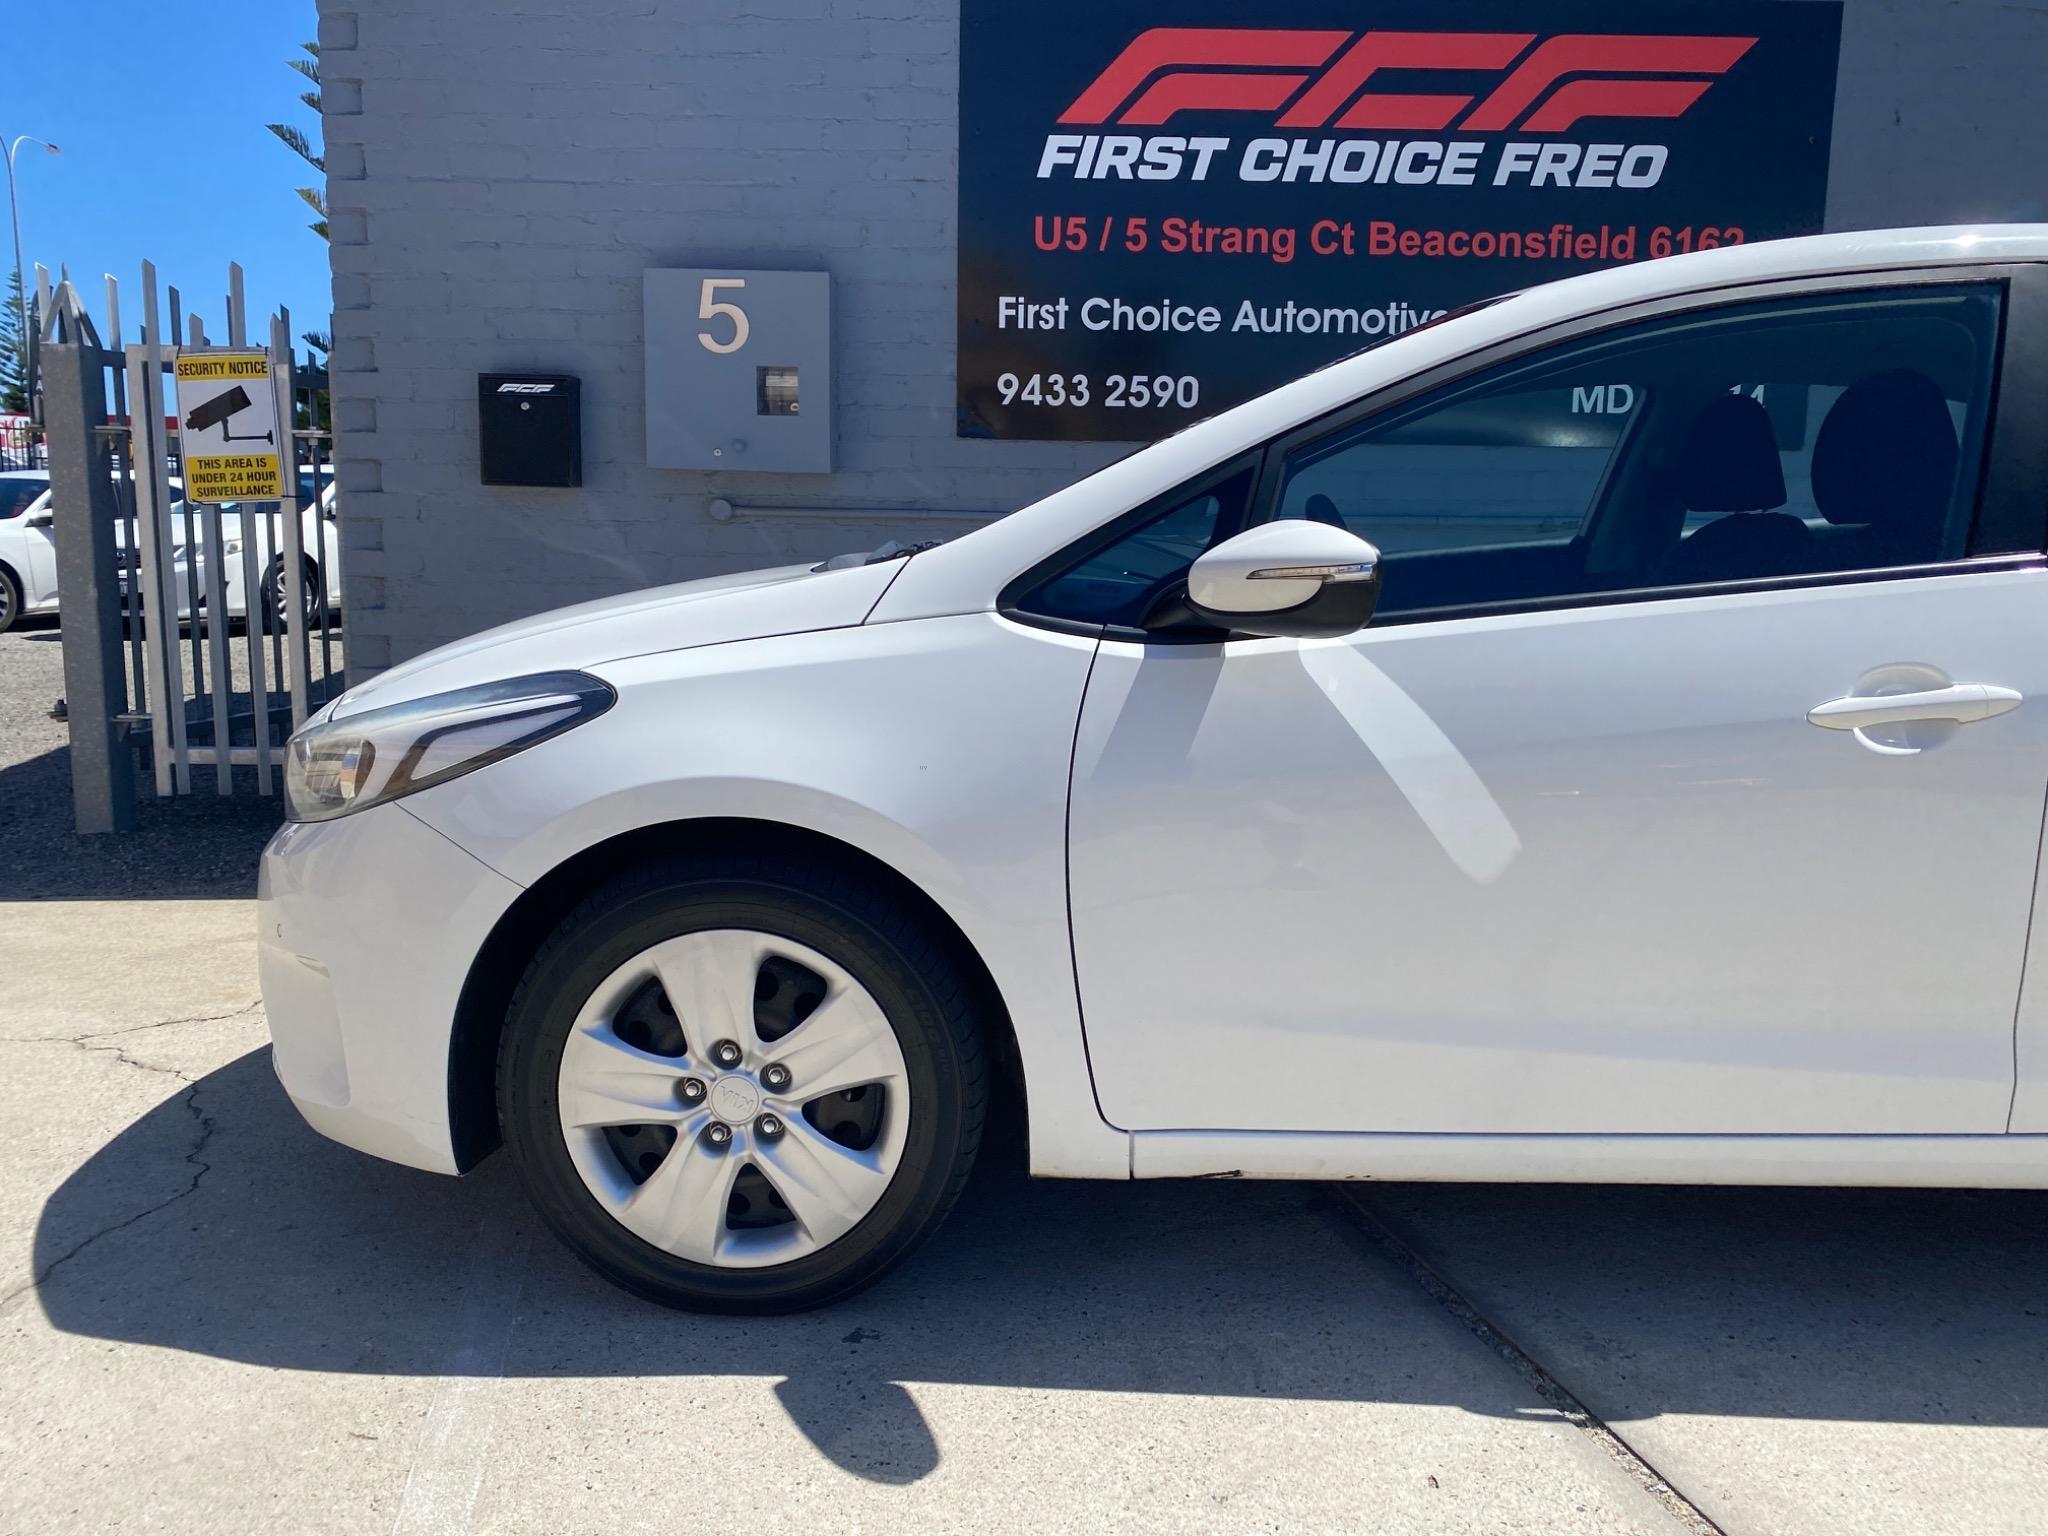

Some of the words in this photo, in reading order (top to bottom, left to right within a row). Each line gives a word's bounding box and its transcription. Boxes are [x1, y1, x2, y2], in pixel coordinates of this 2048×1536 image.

[1036, 134, 1231, 181] FIRST
[1239, 138, 1486, 186] CHOICE
[1492, 142, 1669, 188] FREO
[1034, 215, 1088, 251] U5
[1099, 217, 1113, 251] /
[1125, 217, 1148, 251] 5
[1161, 217, 1296, 263] Strang
[1310, 219, 1356, 255] Ct
[1368, 221, 1636, 260] Beaconsfield
[697, 278, 750, 354] 5
[998, 296, 1069, 330] First
[1080, 297, 1221, 333] Choice
[177, 362, 226, 376] SECURITY
[229, 361, 268, 375] NOTICE
[997, 373, 1090, 406] 9433
[1104, 375, 1200, 408] 2590
[1571, 383, 1634, 414] MD
[192, 473, 227, 484] UNDER
[230, 472, 243, 483] 24
[246, 471, 277, 483] HOUR
[197, 459, 222, 470] THIS
[224, 459, 252, 469] AREA
[256, 457, 268, 468] IS
[196, 485, 276, 497] SURVEILLANCE
